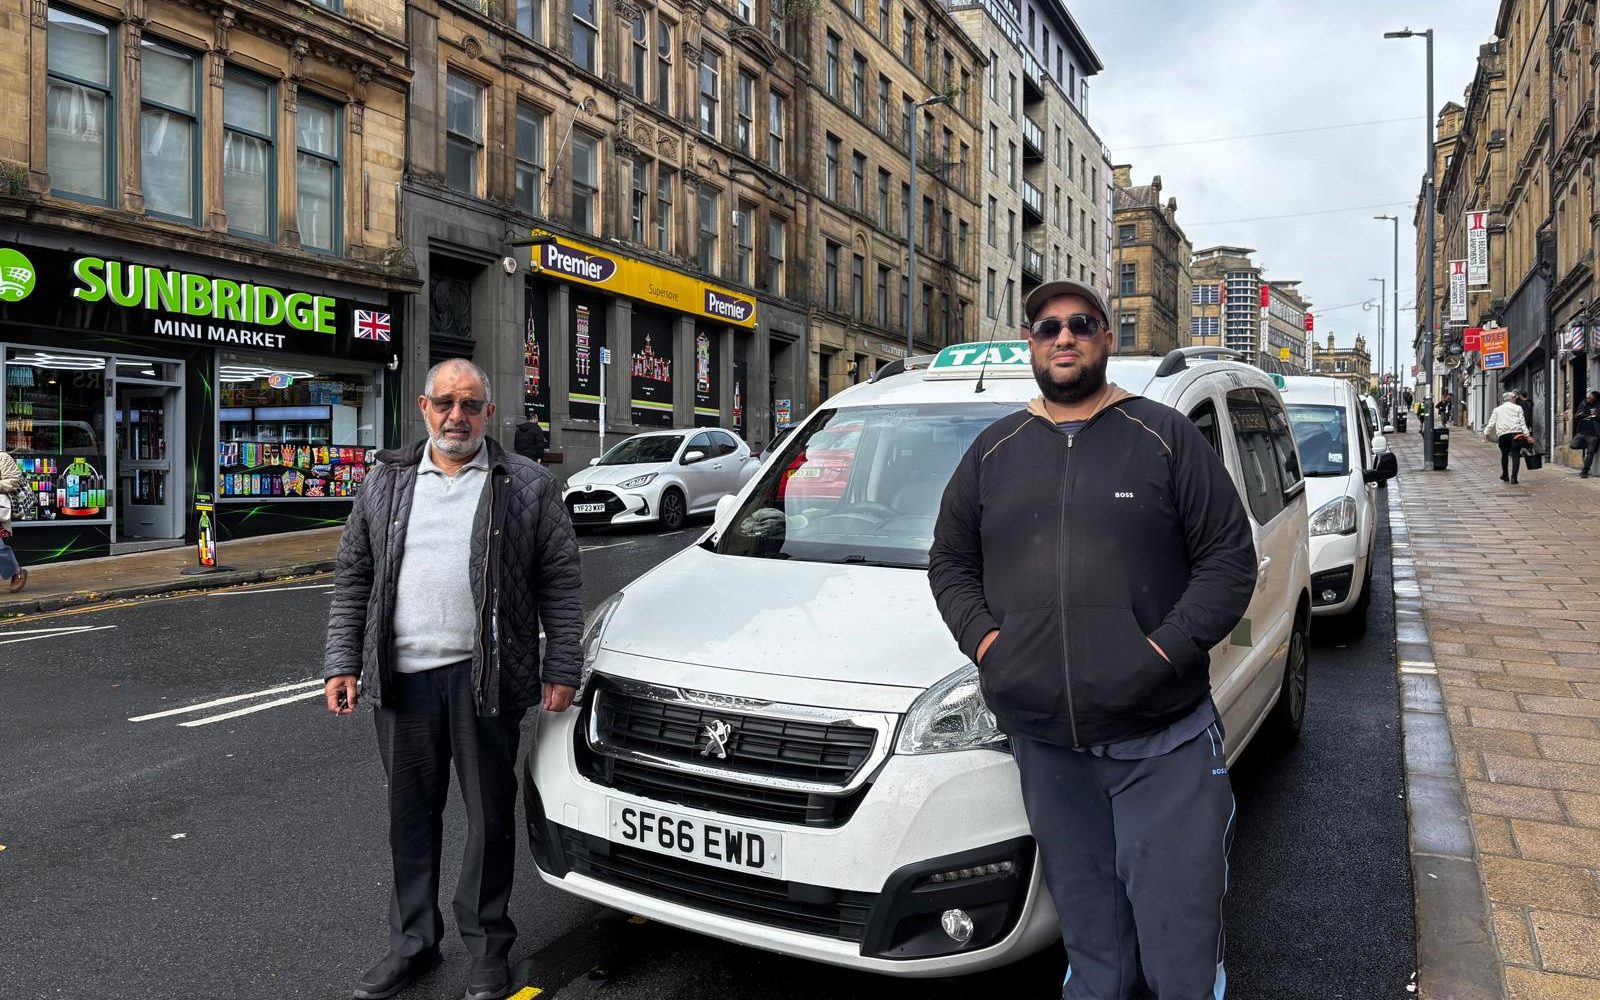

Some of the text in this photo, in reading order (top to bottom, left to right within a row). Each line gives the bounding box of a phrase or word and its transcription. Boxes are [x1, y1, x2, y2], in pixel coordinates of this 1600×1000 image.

[548, 245, 602, 279] Premier
[73, 257, 336, 335] SUNBRIDGE
[648, 283, 679, 302] Supersave
[709, 293, 745, 319] Premier
[154, 319, 286, 348] MINI MARKET
[949, 347, 1032, 366] TAX
[577, 504, 592, 512] YF23
[621, 808, 764, 868] SF66 EWD
